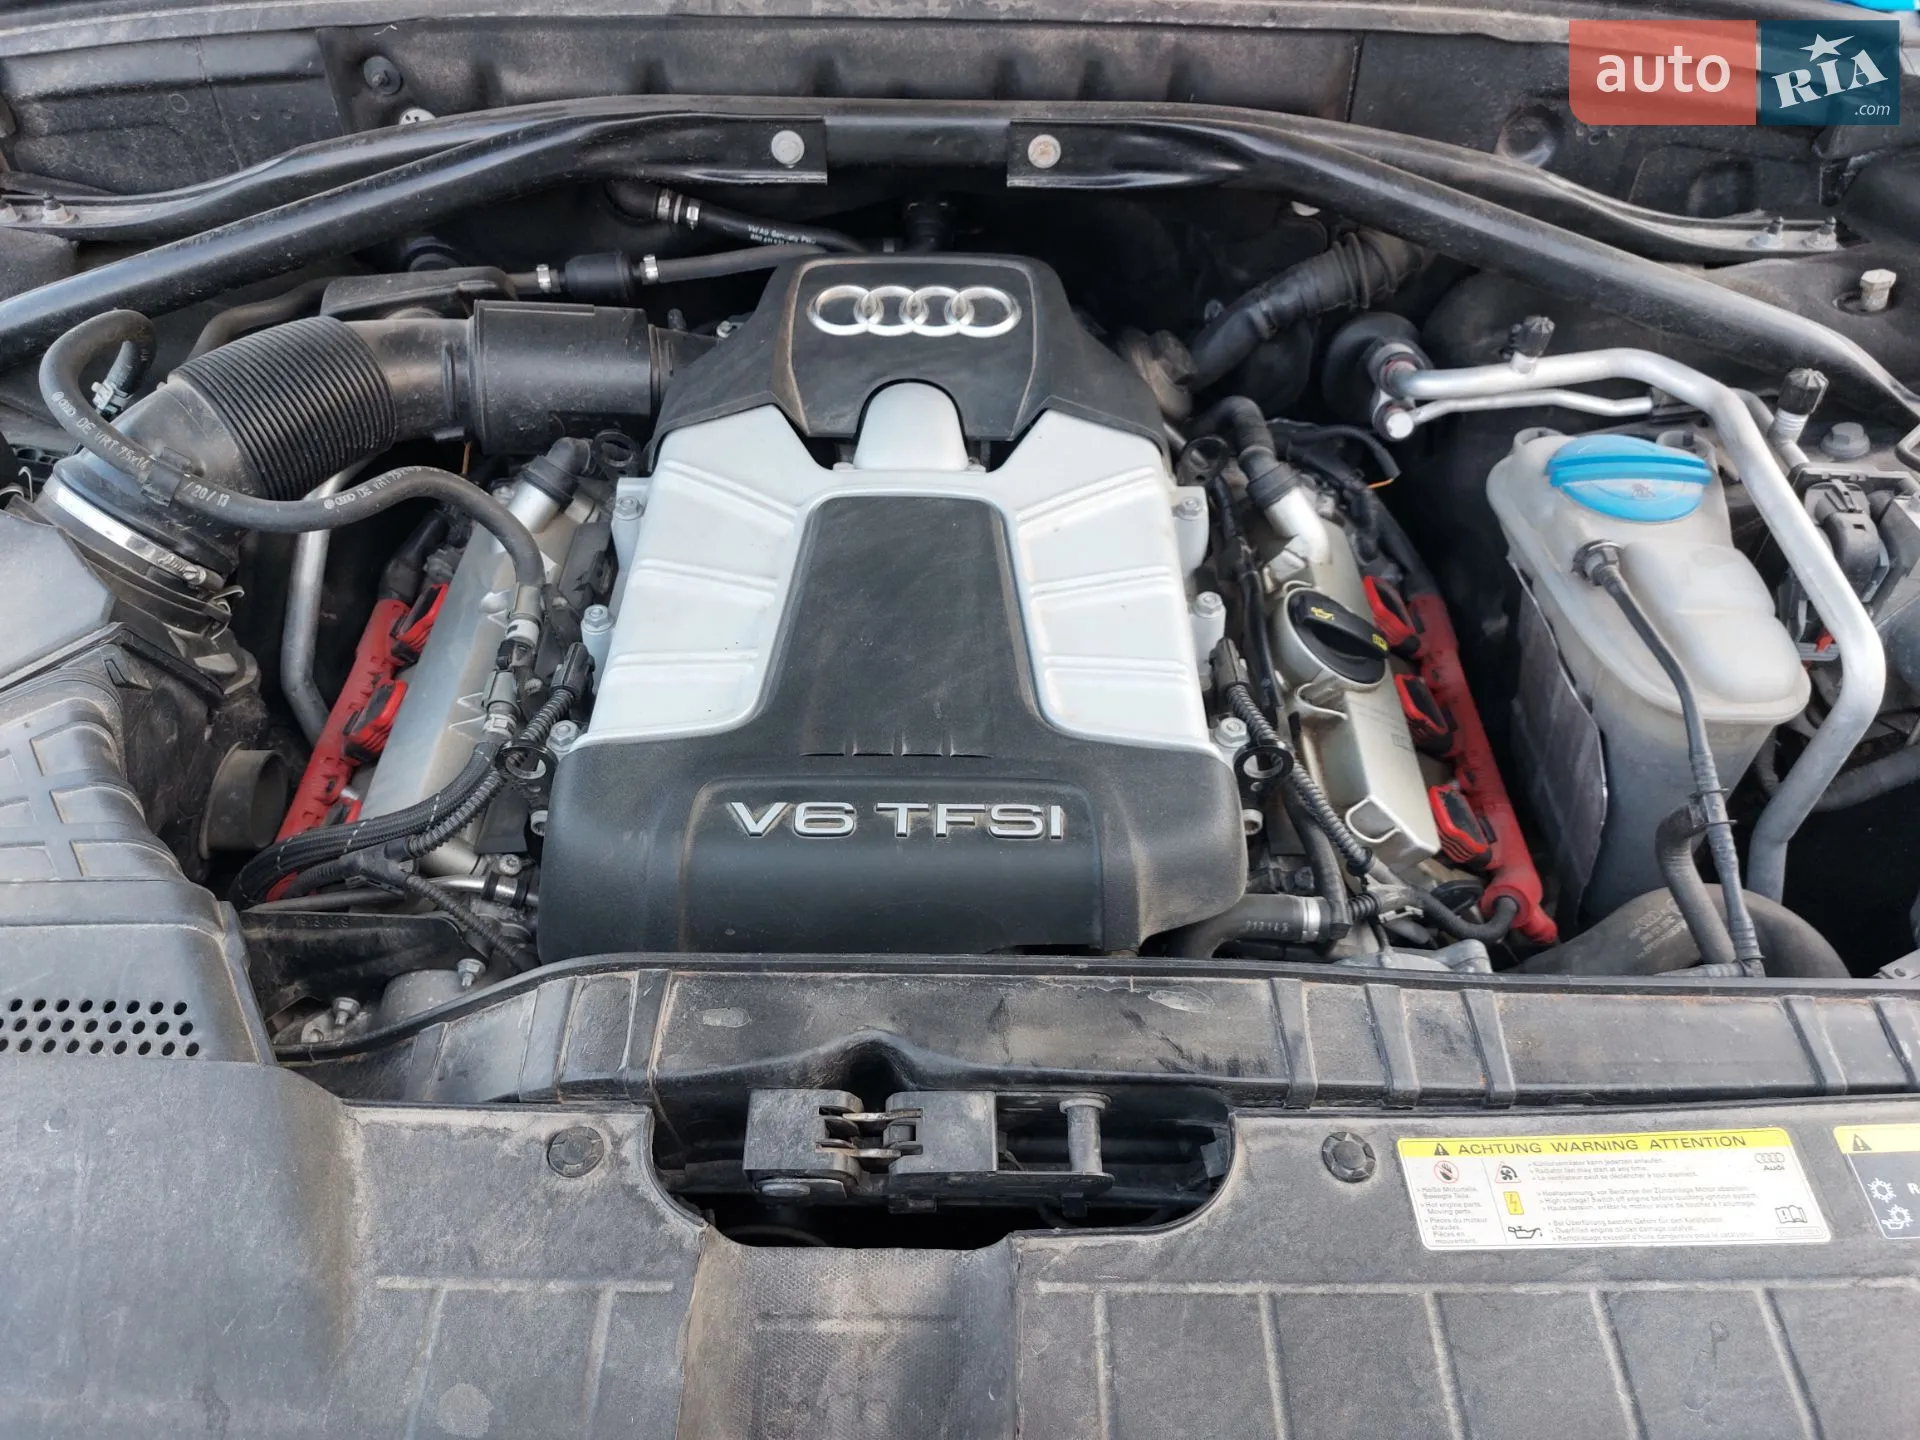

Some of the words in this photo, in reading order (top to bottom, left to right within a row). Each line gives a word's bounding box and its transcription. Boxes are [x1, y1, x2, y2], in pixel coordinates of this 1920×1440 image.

[730, 801, 856, 838] V6
[875, 802, 1065, 840] TFSI
[1457, 1144, 1542, 1155] ACHTUNG
[1551, 1140, 1639, 1153] WARNING
[1648, 1136, 1747, 1150] ATTENTION
